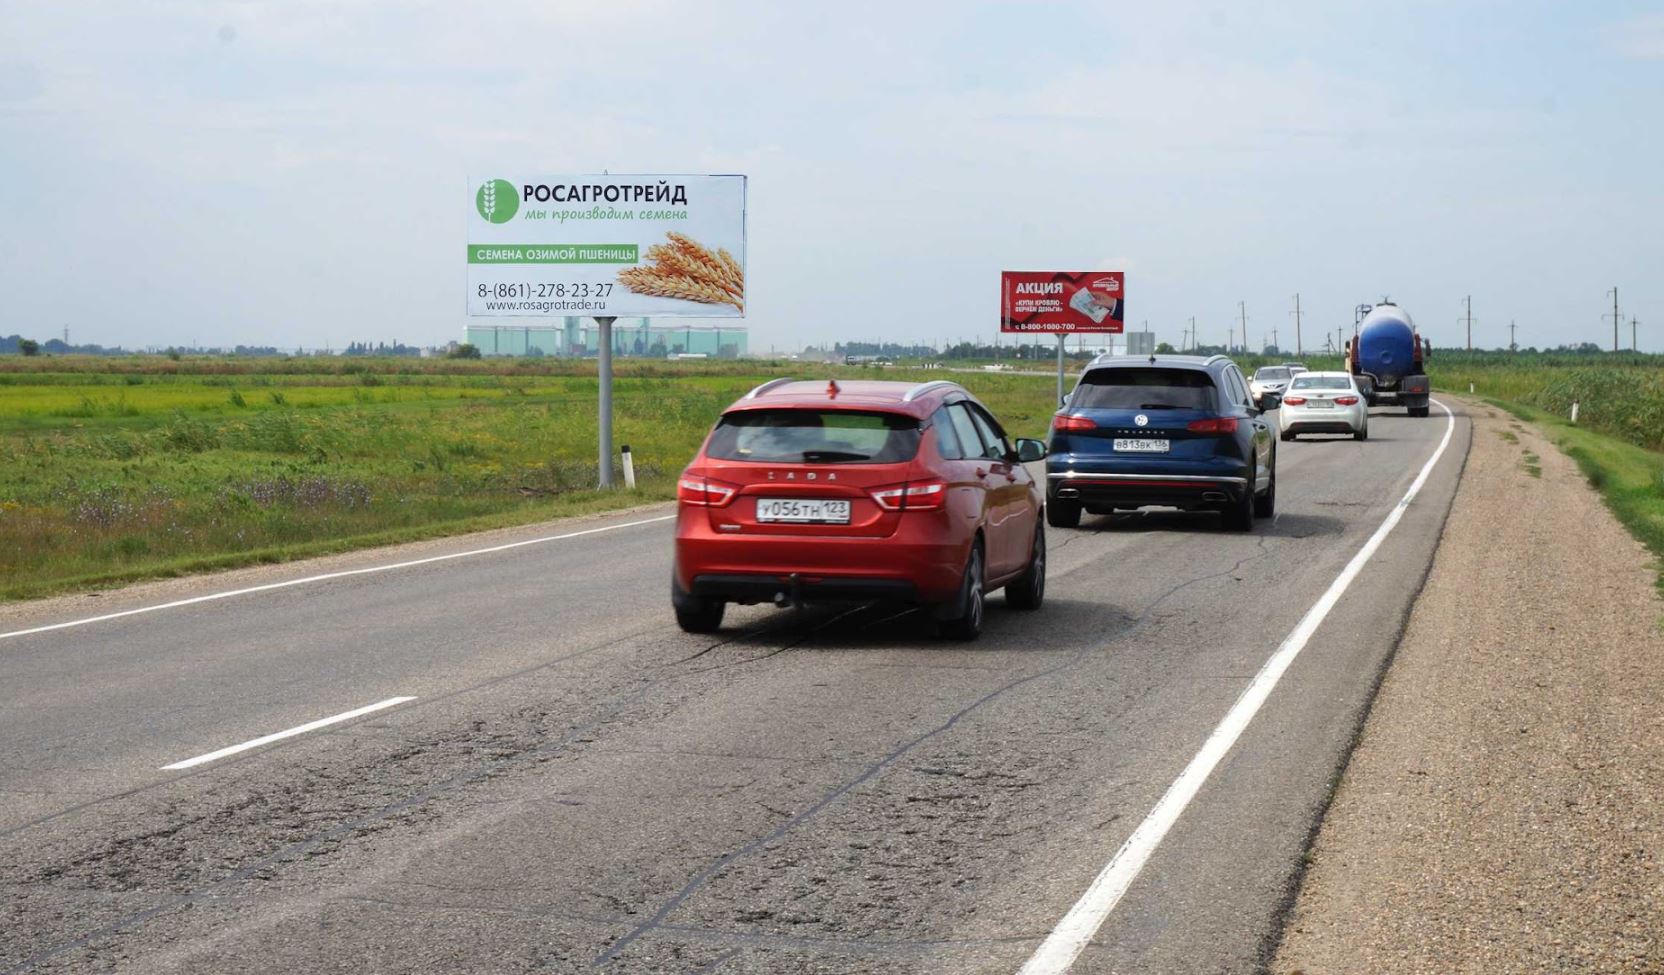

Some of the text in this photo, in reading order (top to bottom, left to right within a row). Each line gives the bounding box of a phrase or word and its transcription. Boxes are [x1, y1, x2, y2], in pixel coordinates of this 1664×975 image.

[523, 180, 688, 205] РОСАГРОТРЕЙД
[524, 206, 688, 224] мы производим семена
[476, 246, 636, 261] СЕМЕНА ОЗИМОЙ ПШЕНИЦЫ
[477, 282, 613, 299] 8-(861)-278-23-27
[1016, 282, 1063, 295] АКЦИЯ
[486, 299, 606, 312] www.rosagrotrade.ru
[768, 471, 837, 480] LADA
[823, 501, 847, 513] 123
